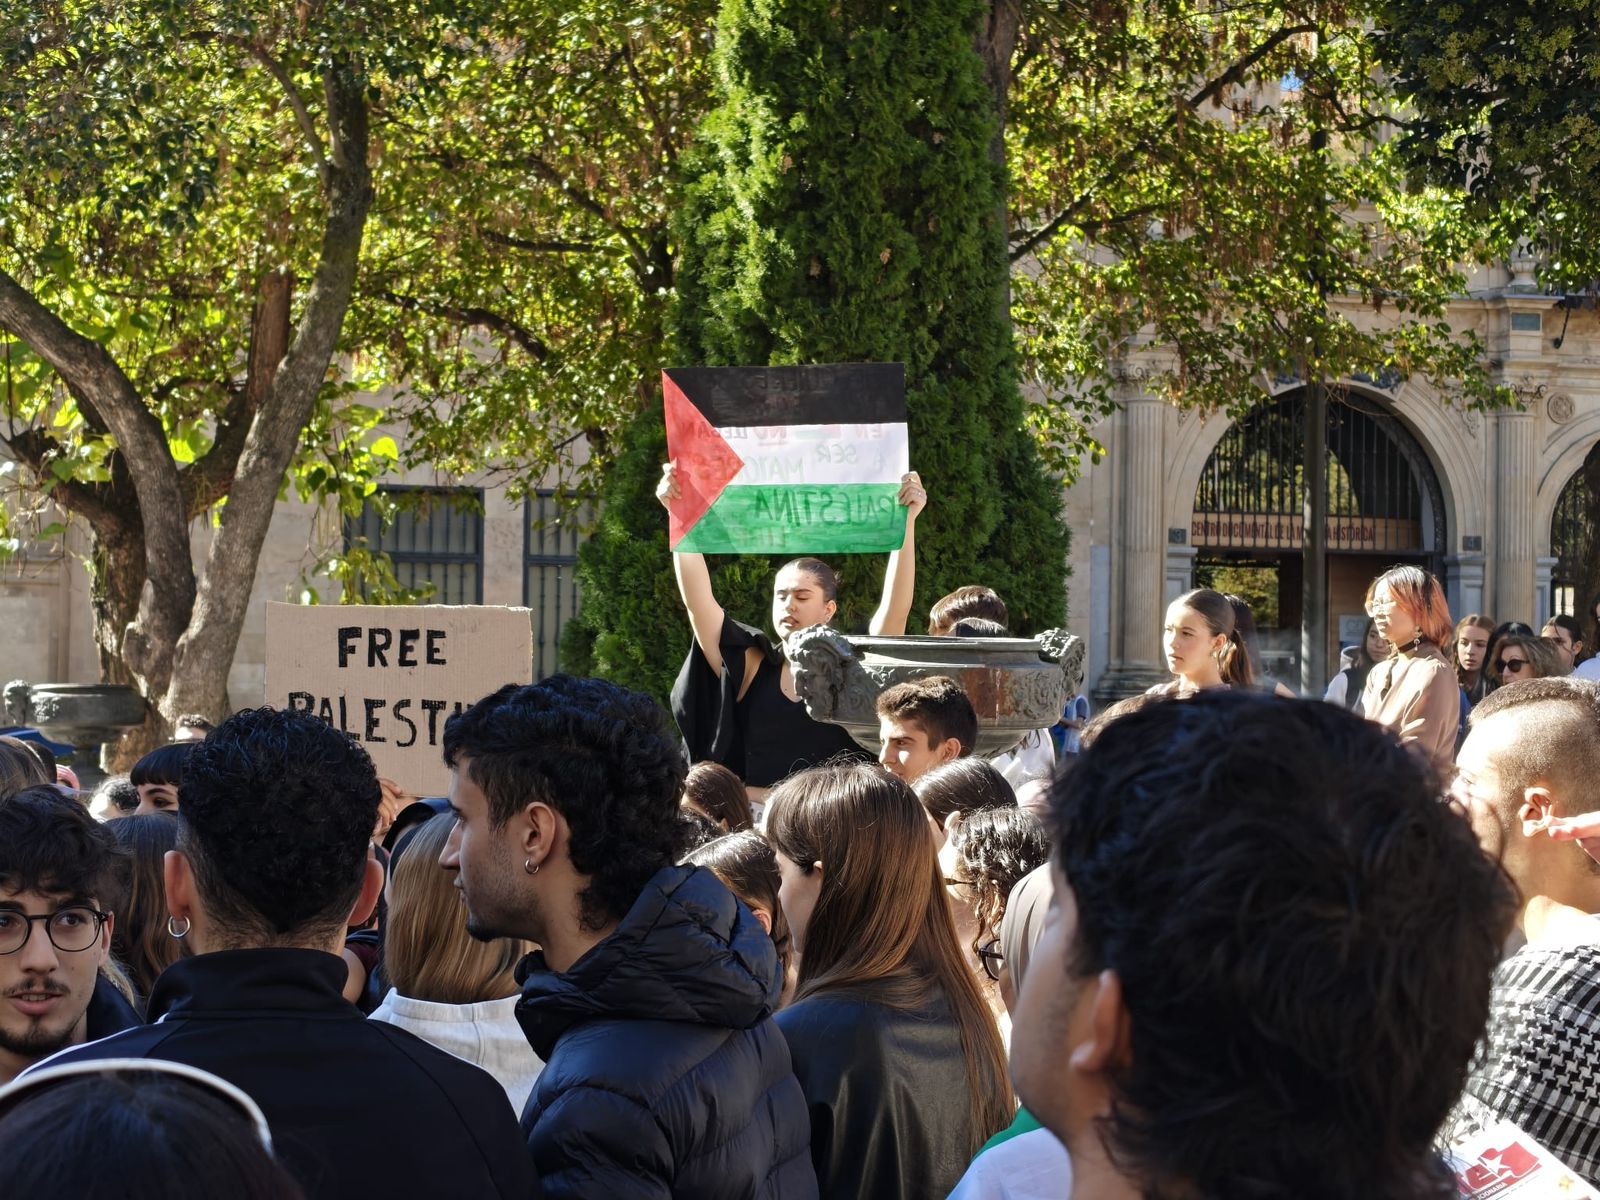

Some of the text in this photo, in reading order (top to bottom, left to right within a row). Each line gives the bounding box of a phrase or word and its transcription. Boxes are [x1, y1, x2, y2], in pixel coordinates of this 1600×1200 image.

[1192, 521, 1222, 536] CENTRO
[338, 627, 447, 667] FREE
[288, 691, 474, 747] PALEST
